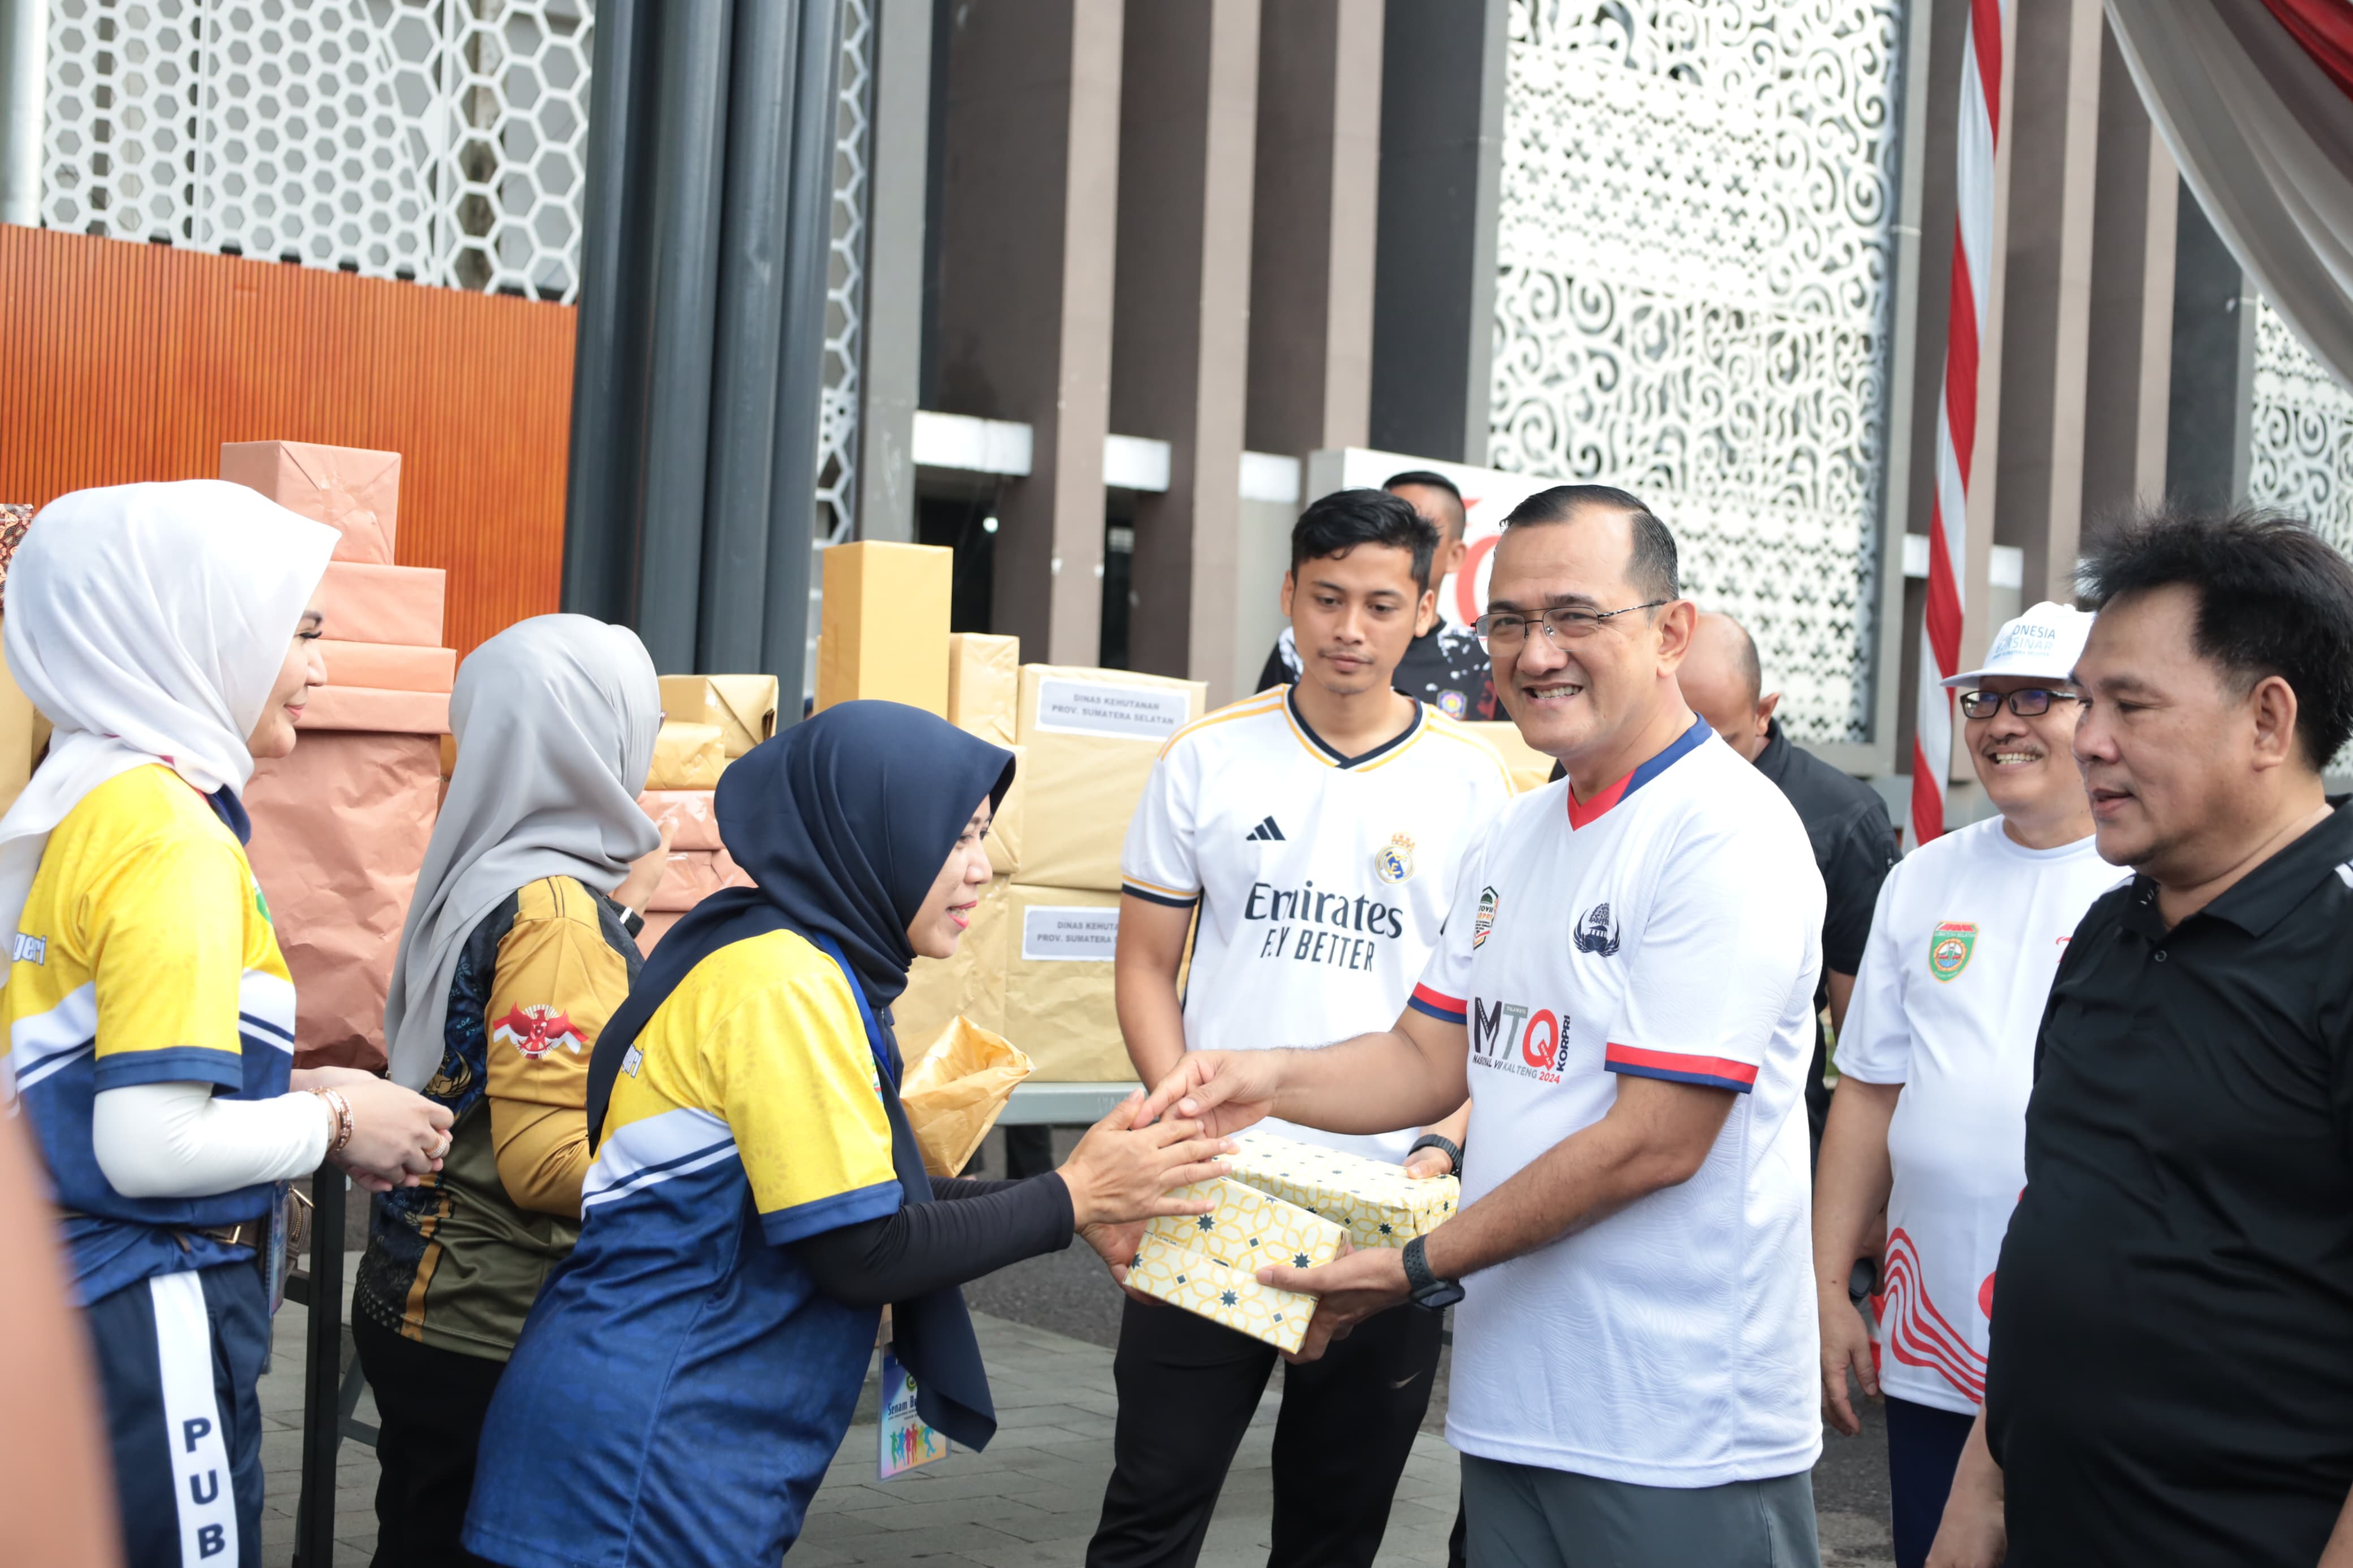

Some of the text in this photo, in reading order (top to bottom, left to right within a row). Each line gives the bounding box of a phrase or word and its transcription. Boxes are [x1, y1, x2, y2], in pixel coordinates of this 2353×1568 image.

[1051, 704, 1174, 725] PROV. SUMATERA SELATAN
[1074, 693, 1159, 710] DINAS KEHUTANAN
[1244, 880, 1403, 939] Emirates
[1294, 929, 1374, 972] BETTER
[1474, 997, 1559, 1071] MTQ
[1556, 1015, 1570, 1072] KORPRI
[1502, 1061, 1537, 1078] KALTENG
[1539, 1072, 1561, 1084] 2024
[888, 1401, 907, 1415] Senam
